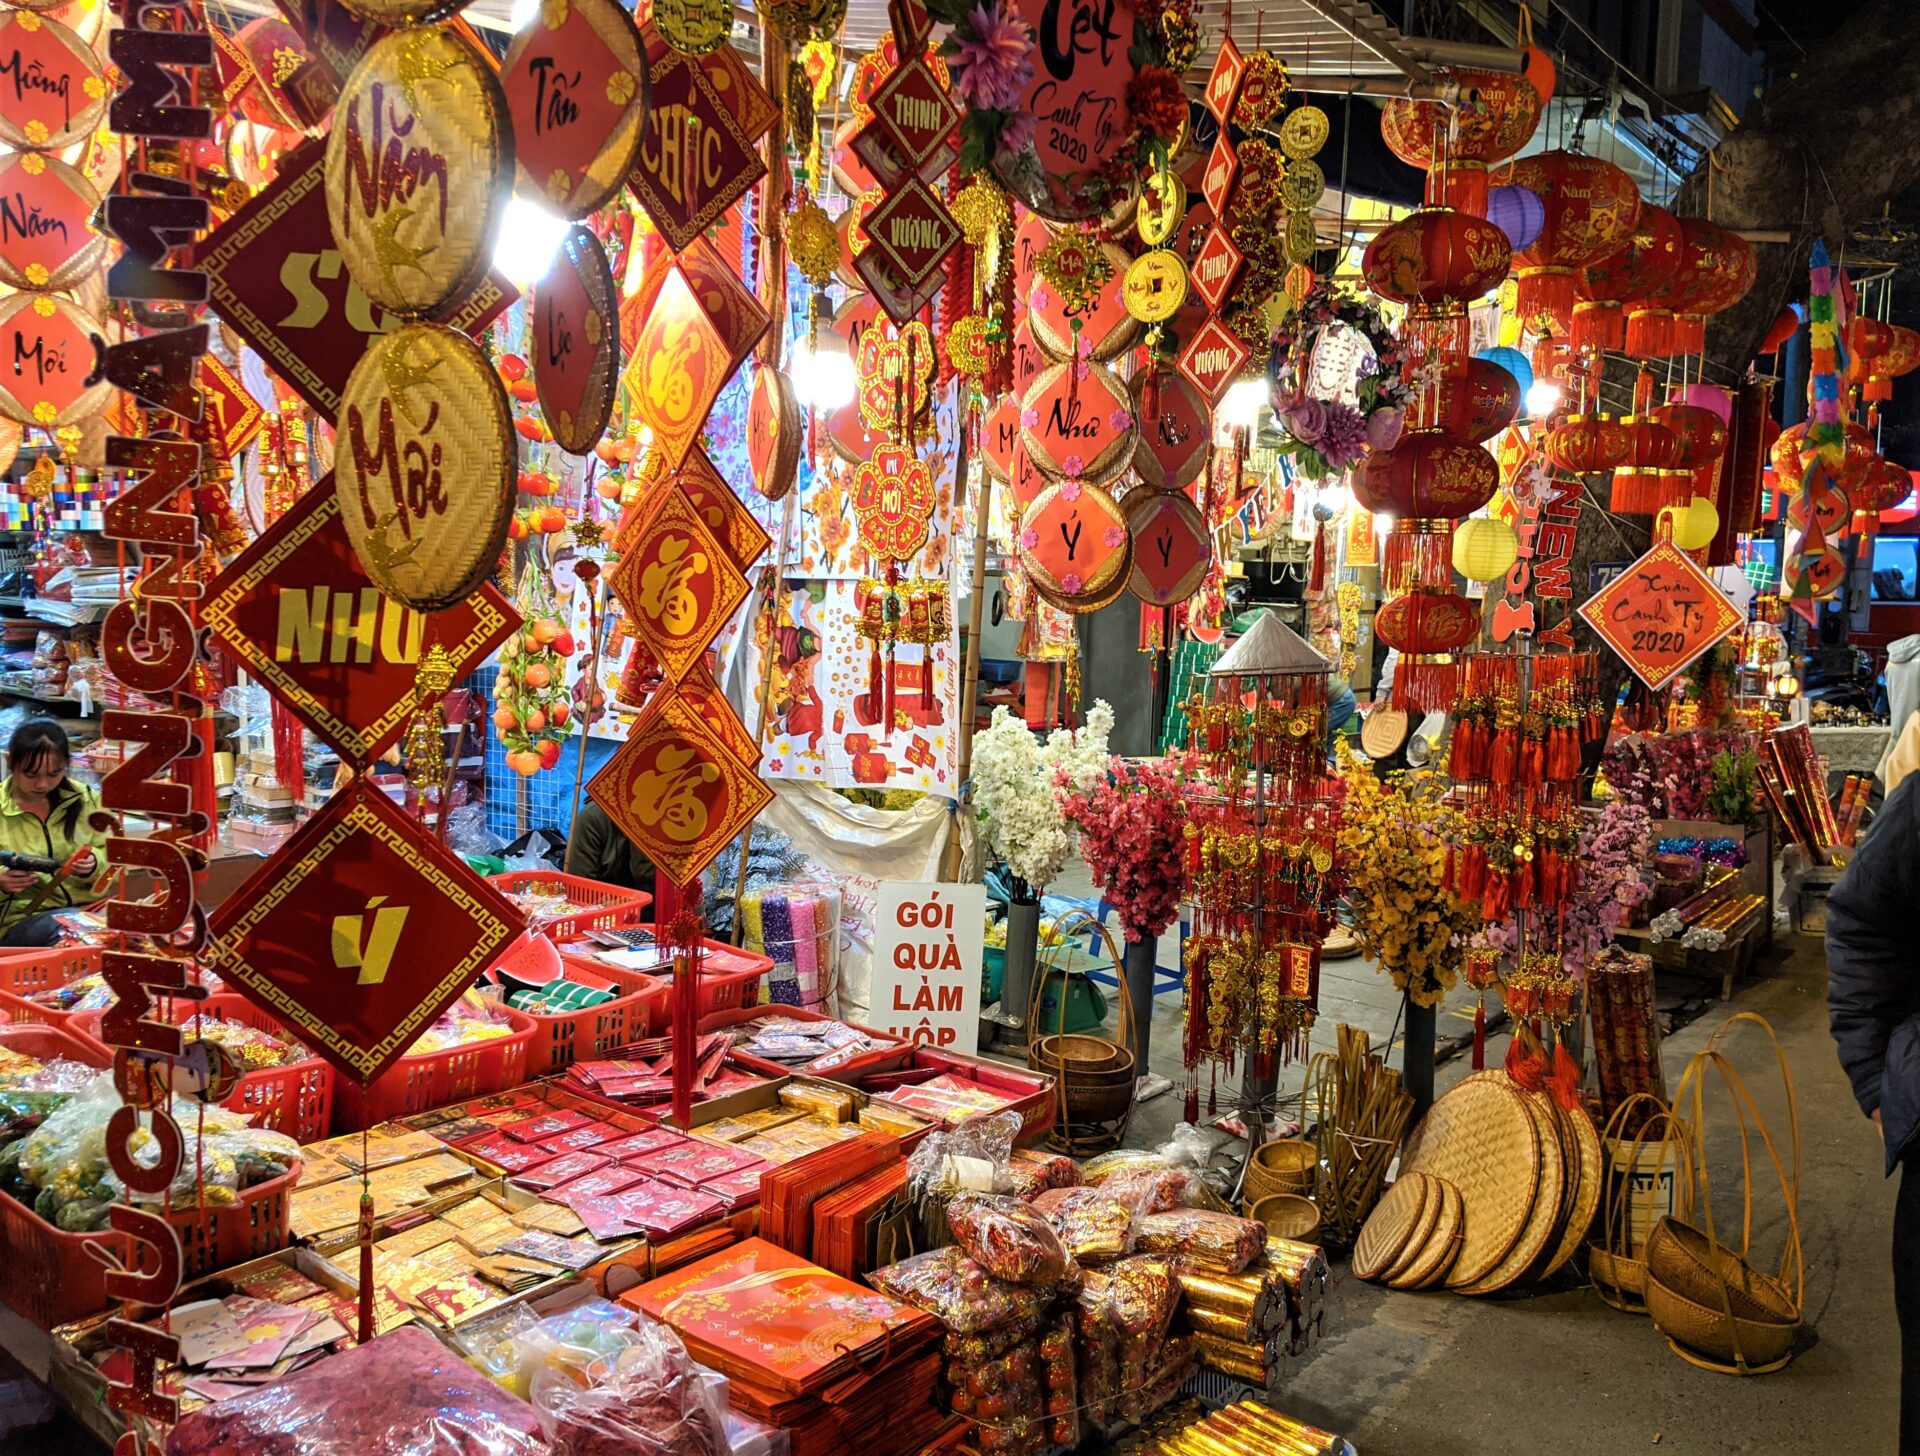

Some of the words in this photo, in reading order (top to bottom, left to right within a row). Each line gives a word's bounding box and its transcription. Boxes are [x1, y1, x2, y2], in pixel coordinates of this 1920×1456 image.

[529, 57, 581, 136] Tấn
[1213, 65, 1234, 101] AN
[895, 93, 941, 134] THỊNH
[346, 81, 448, 239] Năm
[1048, 128, 1087, 164] 2020
[1, 192, 67, 246] Năm
[891, 213, 941, 254] VƯỢNG
[1202, 251, 1228, 284] THỊNH
[14, 331, 67, 386] Mới
[1194, 347, 1230, 377] VƯỢNG
[1045, 398, 1100, 440] Như
[882, 485, 901, 514] MỚI
[1060, 510, 1081, 560] Ý
[1157, 528, 1173, 567] Ý
[1638, 573, 1691, 593] Xuân
[1612, 598, 1668, 624] Canh
[1673, 600, 1709, 634] Tý
[1632, 630, 1685, 653] 2020
[896, 890, 954, 929] GÓI
[331, 895, 410, 985] Ý
[893, 934, 962, 971] QUÀ
[893, 975, 963, 1012] LÀM
